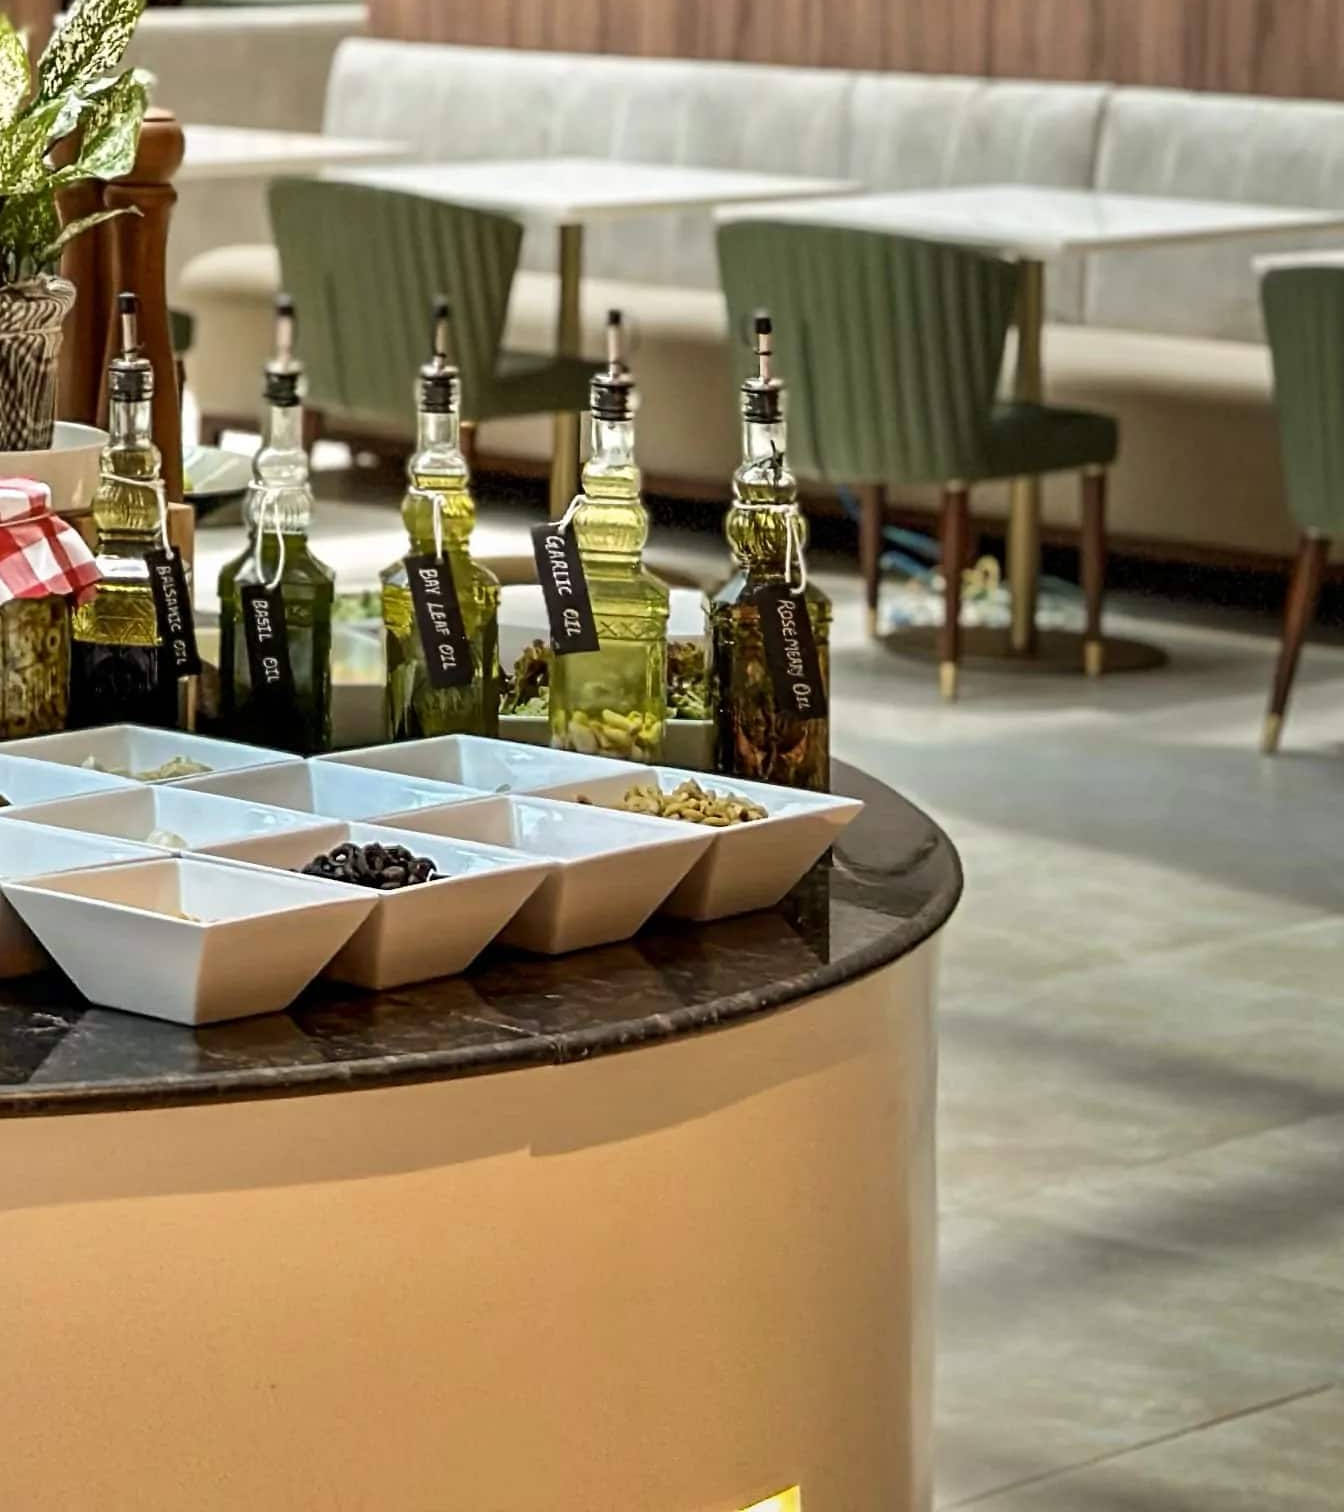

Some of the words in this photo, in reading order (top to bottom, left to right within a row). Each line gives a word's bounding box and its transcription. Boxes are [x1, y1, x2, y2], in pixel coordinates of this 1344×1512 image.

[418, 568, 441, 595] BAY
[545, 535, 572, 596] GARLIC
[562, 608, 582, 637] OIL
[426, 602, 450, 637] LEAF
[251, 599, 272, 642] BASIL
[263, 656, 280, 683] OIL
[438, 644, 457, 671] OIL
[792, 682, 811, 711] OIL
